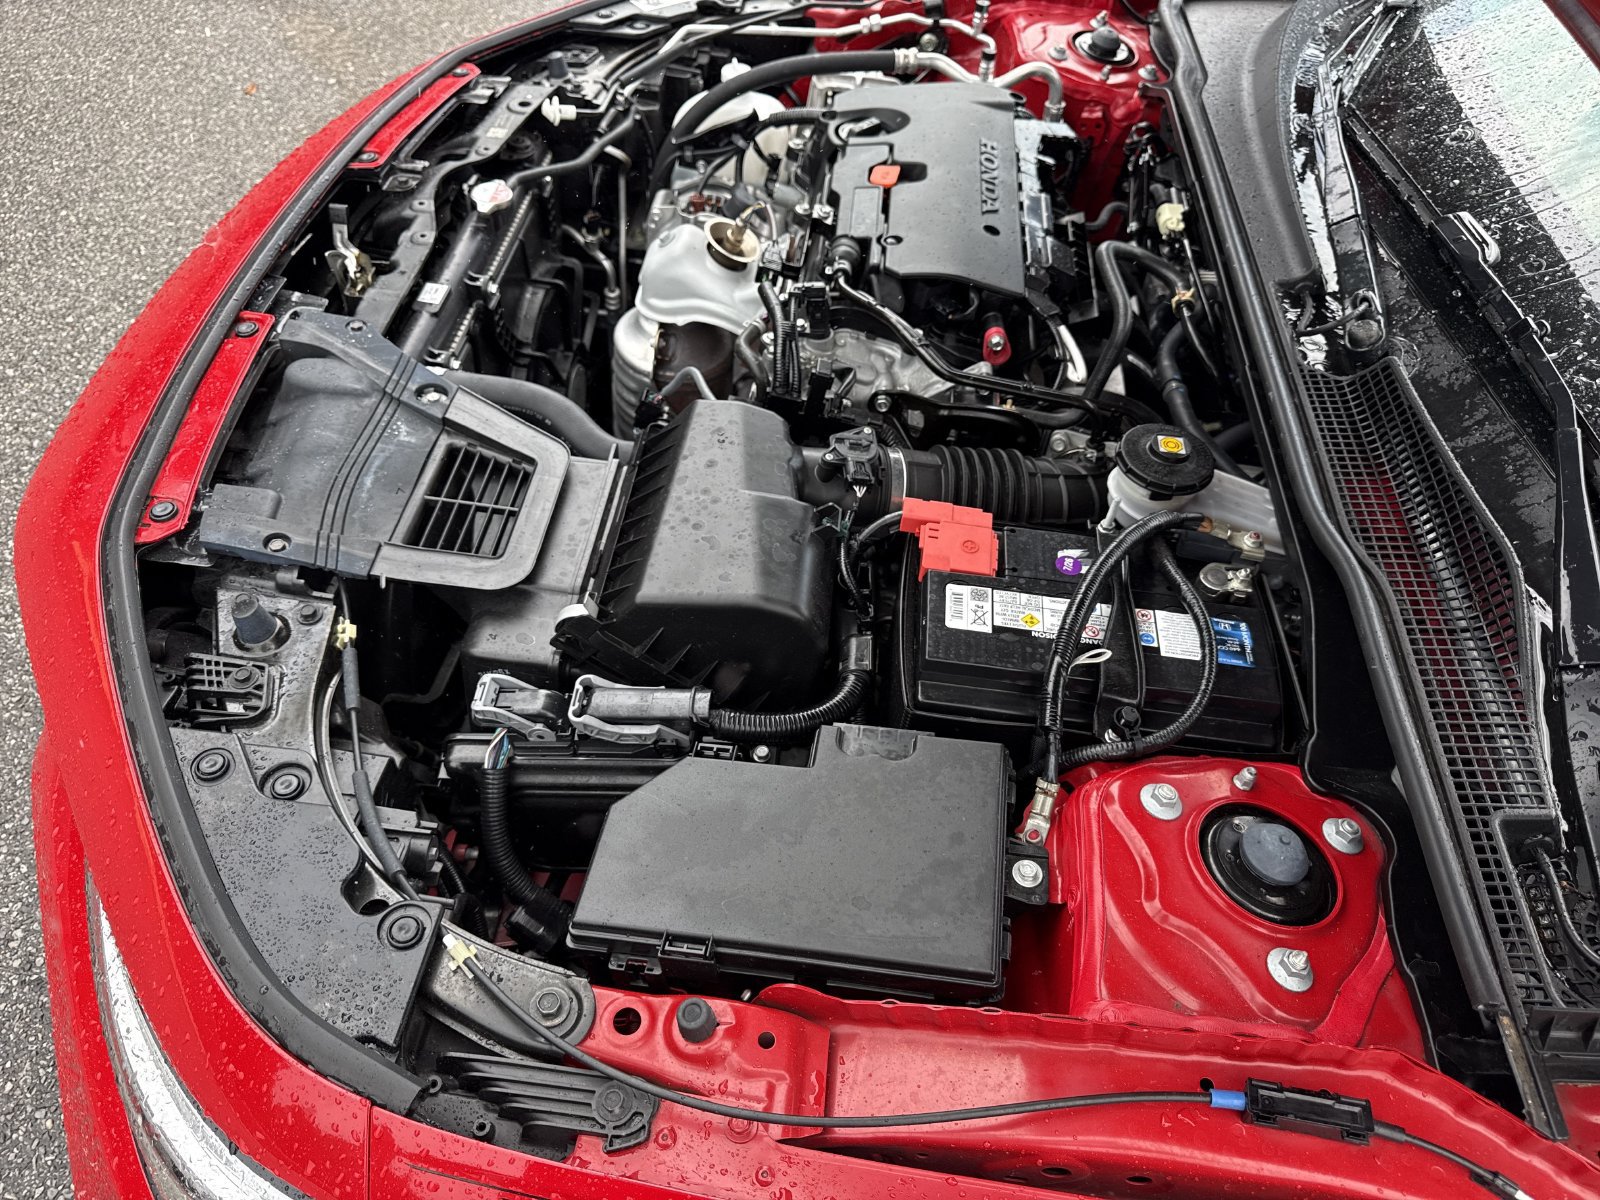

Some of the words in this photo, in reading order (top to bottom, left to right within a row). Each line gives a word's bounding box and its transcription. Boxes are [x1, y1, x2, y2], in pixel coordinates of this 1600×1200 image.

[979, 138, 999, 216] HONDA
[1063, 558, 1074, 571] 7/26
[1032, 631, 1057, 640] OISON
